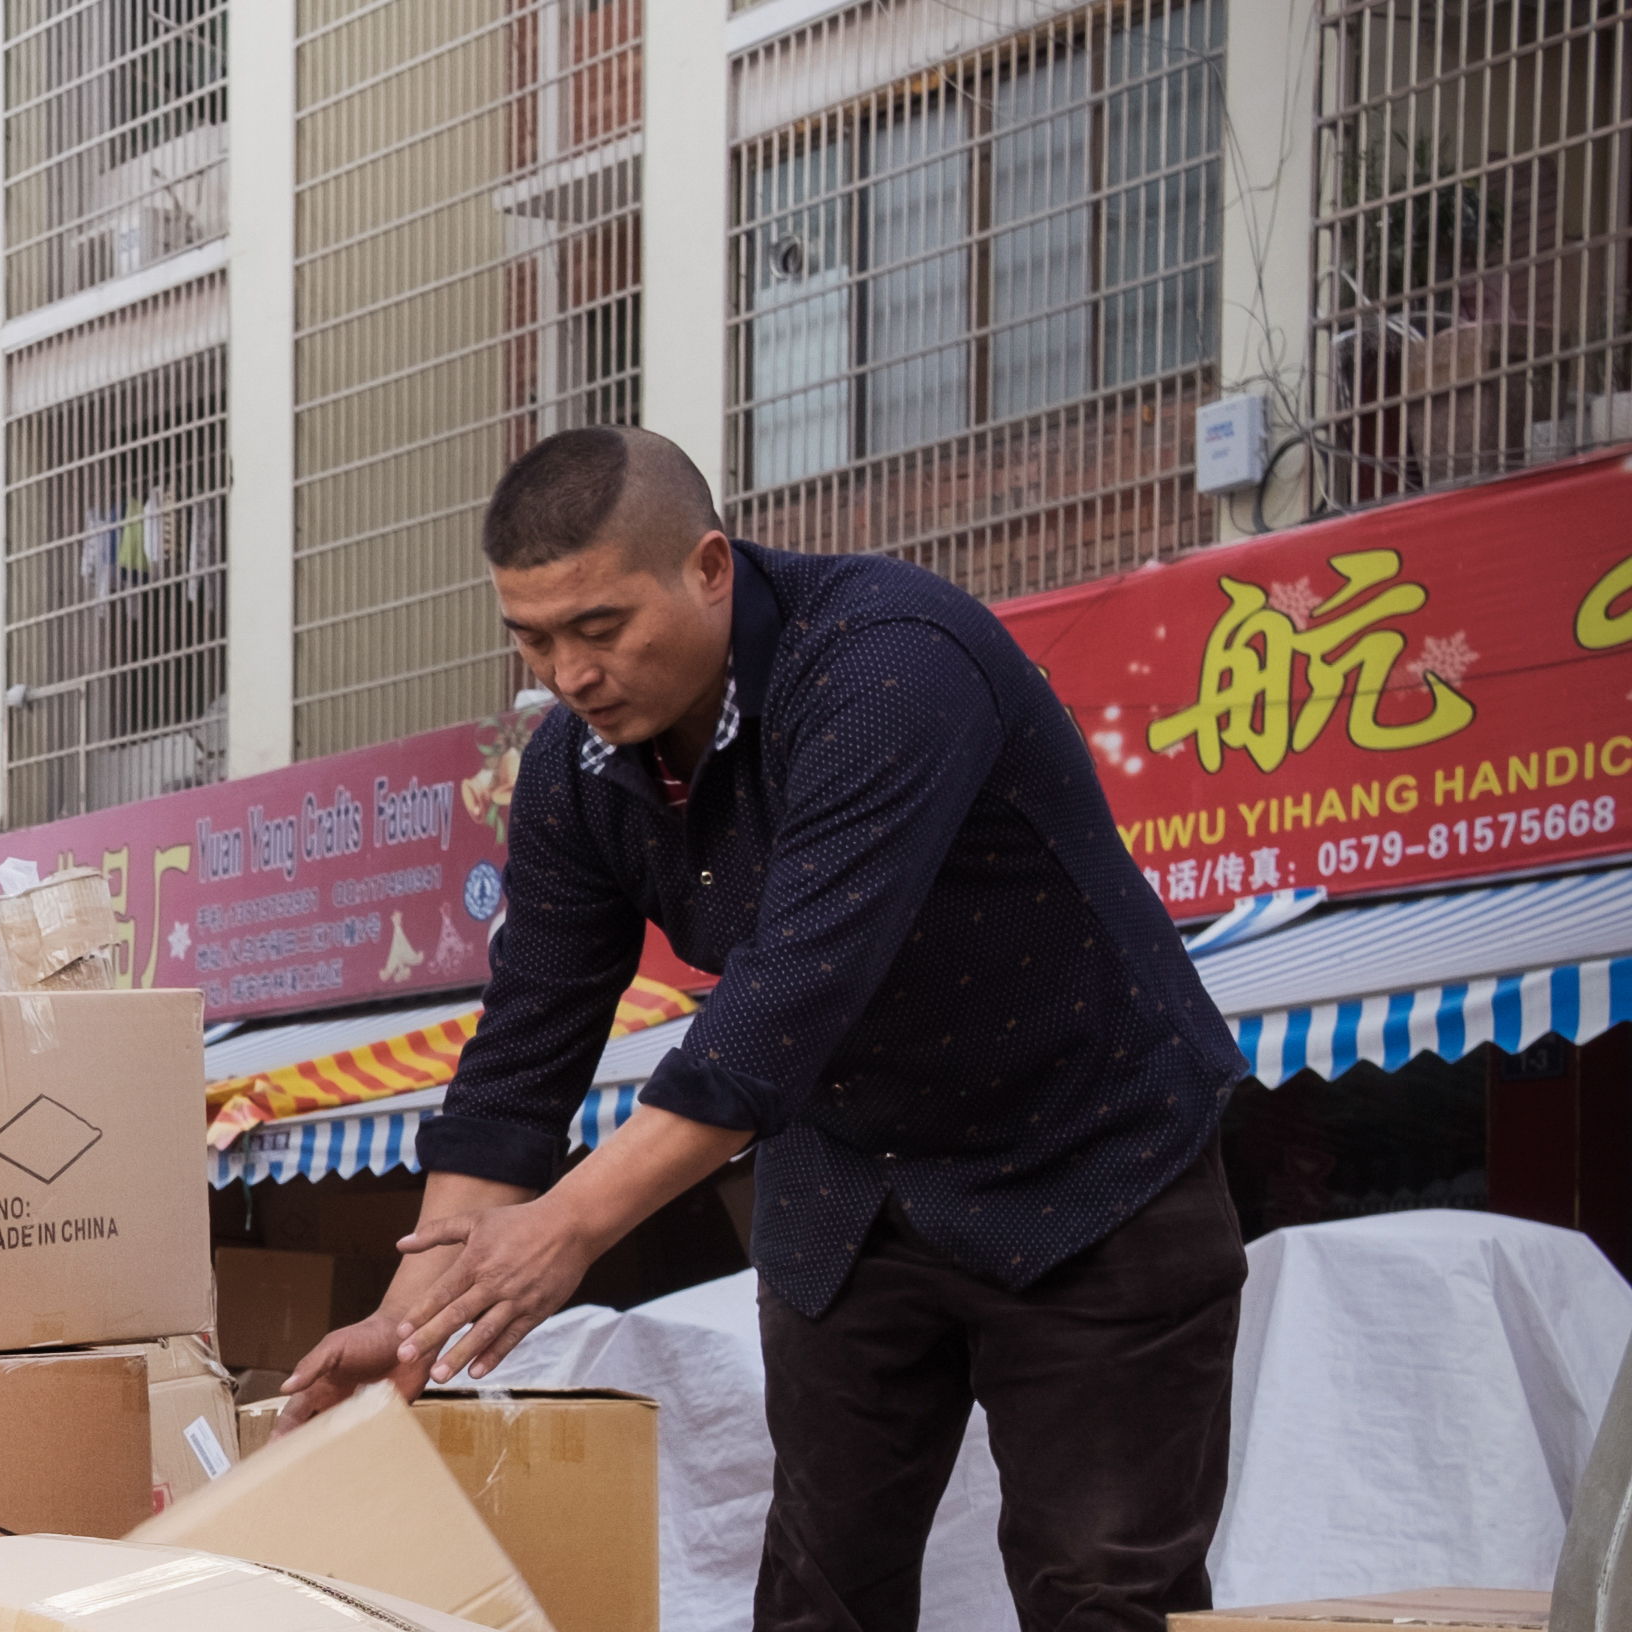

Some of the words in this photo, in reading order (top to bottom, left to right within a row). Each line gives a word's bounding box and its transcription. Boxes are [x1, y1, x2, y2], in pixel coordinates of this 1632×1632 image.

[196, 816, 244, 884] Yuan
[248, 804, 297, 882] Yang
[301, 784, 363, 863] Crafts
[374, 775, 455, 851] Factory
[1117, 807, 1225, 856] YIWU
[1238, 775, 1419, 836] YIHANG
[1434, 735, 1632, 805] HANDIC
[1318, 796, 1616, 877] 0579-81575668
[38, 1221, 56, 1247] IN
[61, 1215, 119, 1244] CHINA
